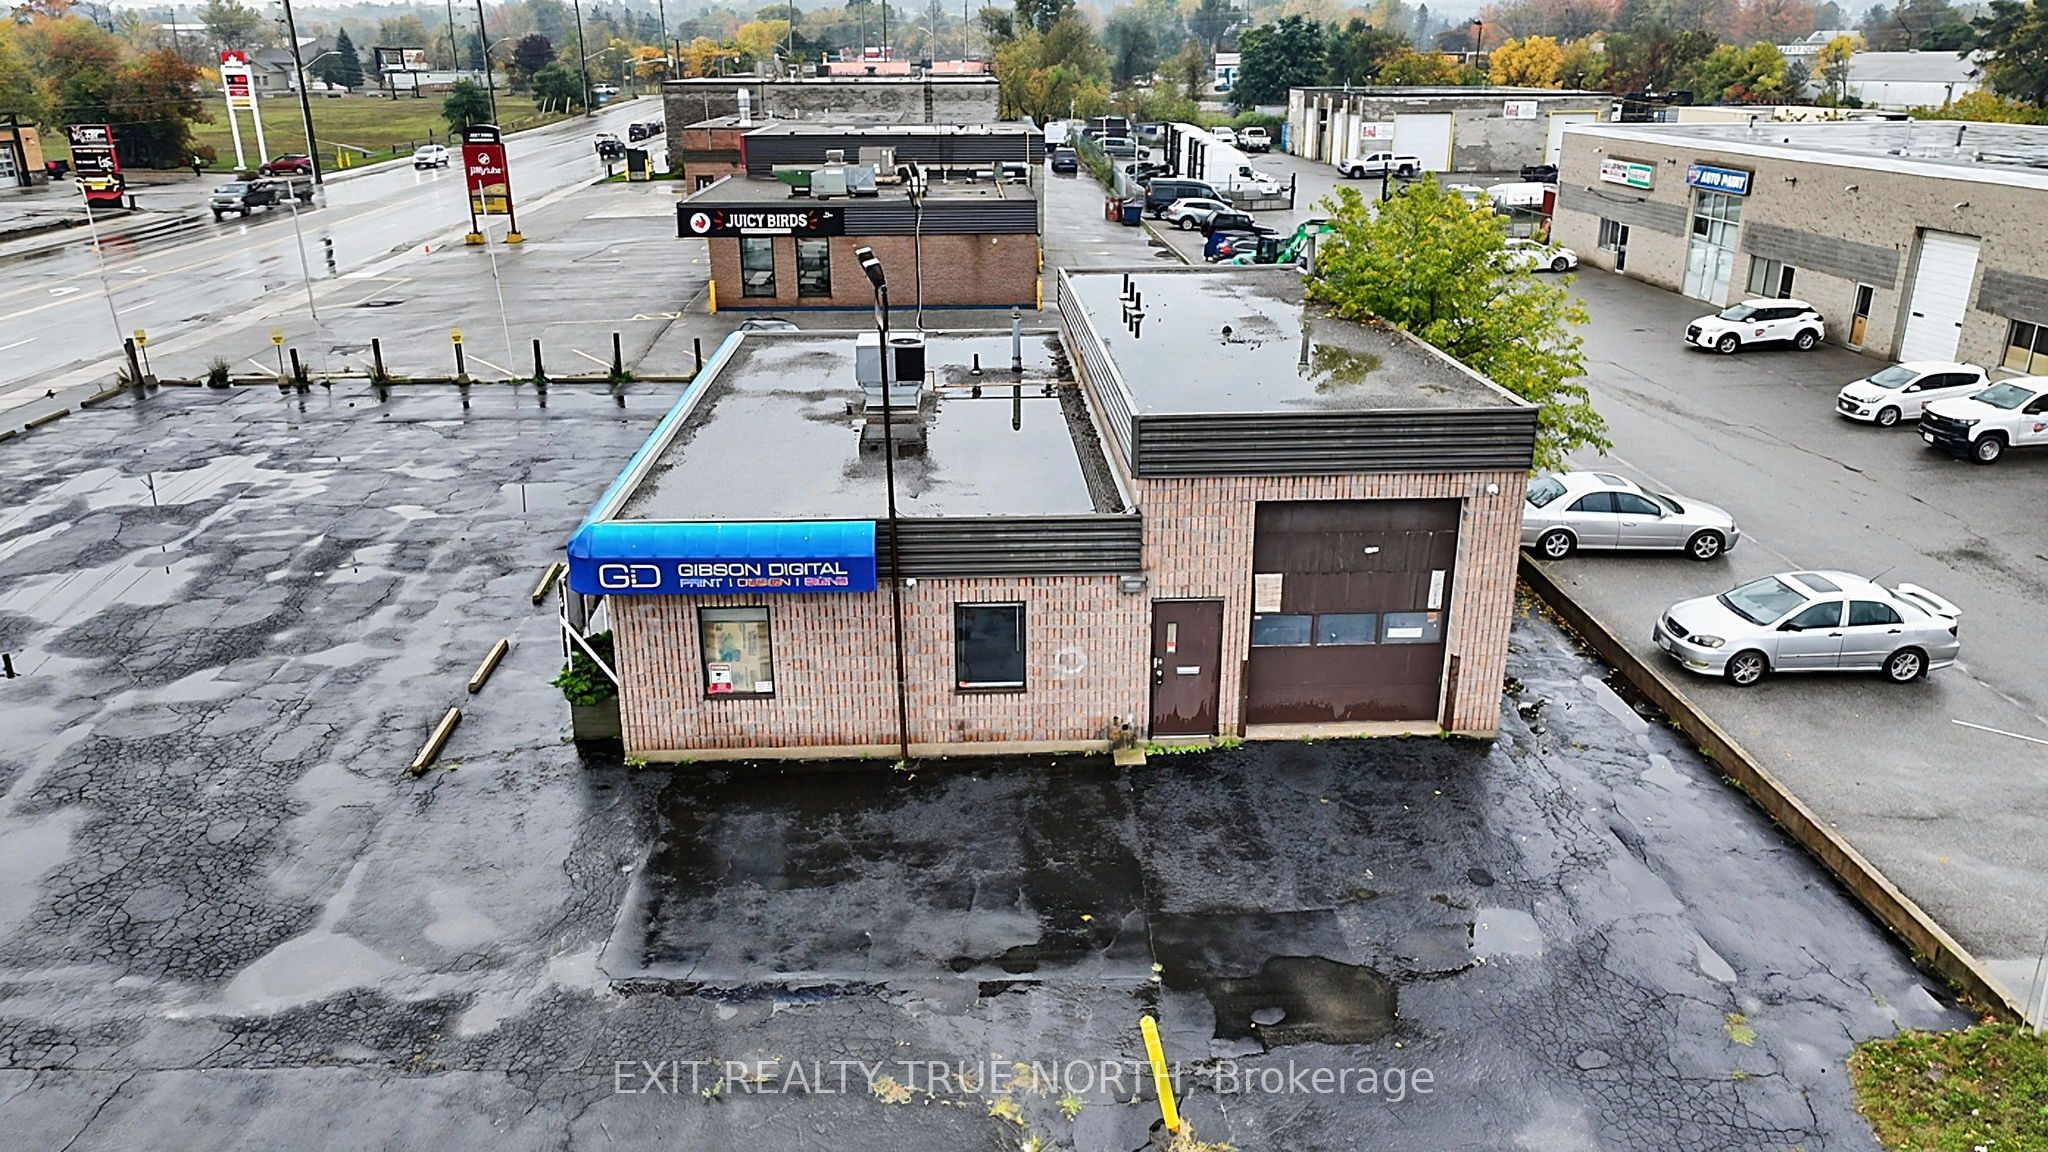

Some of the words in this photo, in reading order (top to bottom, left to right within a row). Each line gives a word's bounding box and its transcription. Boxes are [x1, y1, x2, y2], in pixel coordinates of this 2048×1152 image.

[1700, 171, 1720, 185] AUTO
[1720, 174, 1745, 189] PAINT
[725, 214, 765, 227] JUICY
[767, 214, 807, 227] BIRDS
[677, 563, 761, 577] GIBSON
[767, 562, 848, 576] DIGITAL
[679, 578, 723, 588] PRINT
[737, 577, 791, 587] DESIGN
[804, 576, 848, 586] SIGNS
